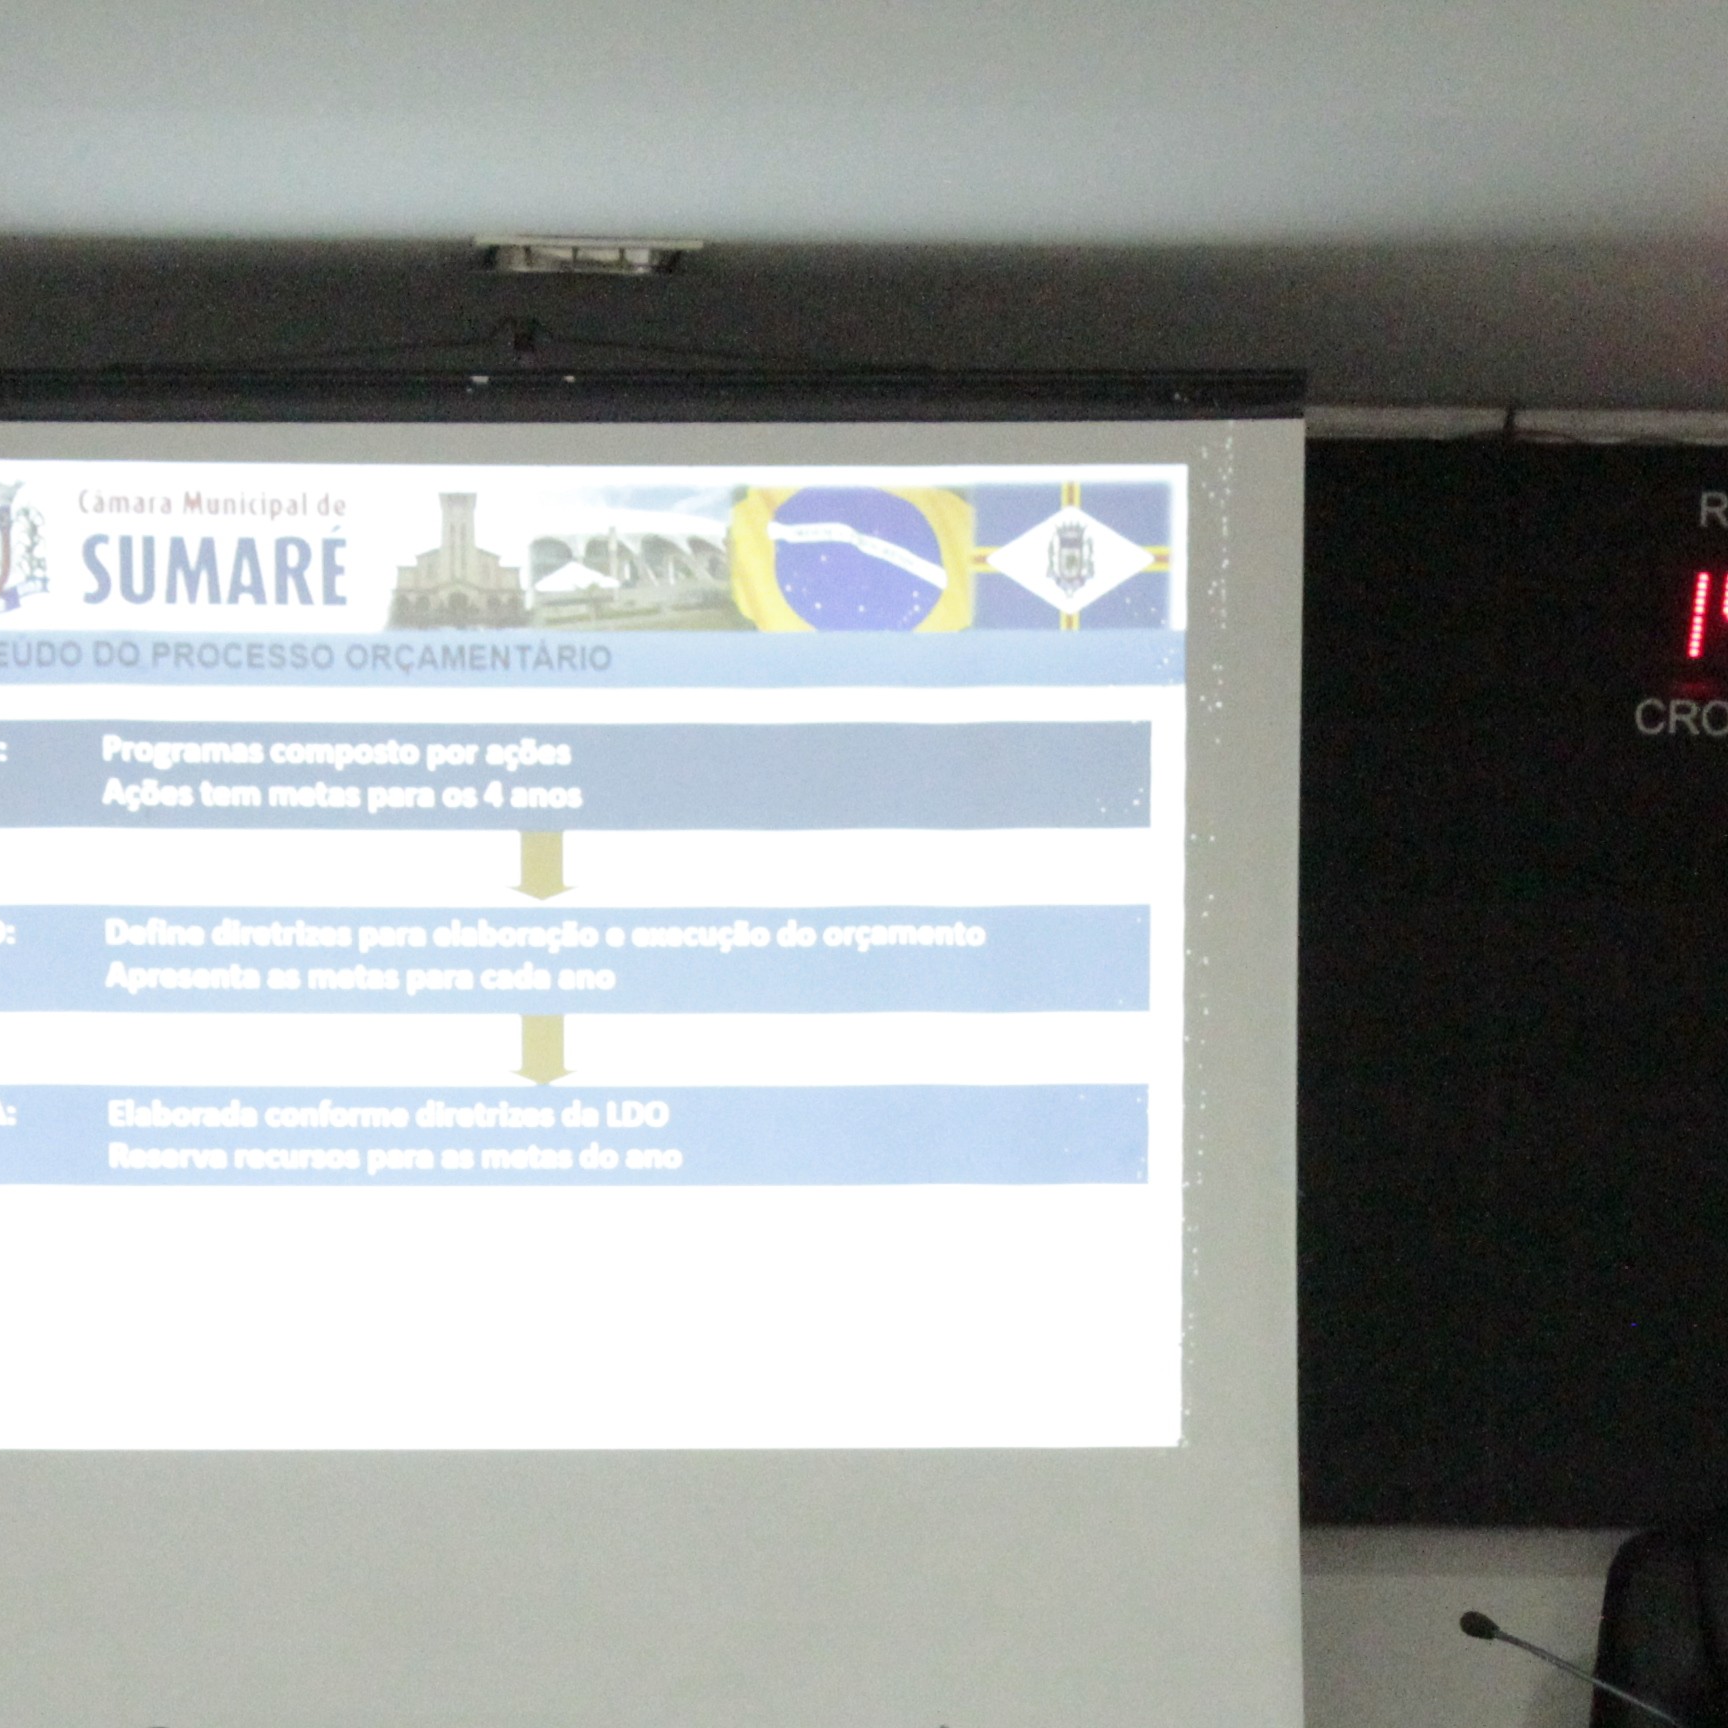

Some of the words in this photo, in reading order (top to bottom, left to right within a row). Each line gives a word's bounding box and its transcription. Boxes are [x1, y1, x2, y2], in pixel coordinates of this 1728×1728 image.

[77, 489, 174, 516] Câmara
[181, 491, 308, 521] Municipal
[317, 493, 348, 517] de
[81, 526, 349, 606] SUMARÉ
[92, 638, 142, 669] DO
[151, 641, 335, 672] PROCESSO
[344, 639, 613, 676] ORÇAMENTÁRIO
[103, 735, 264, 769] Programas
[270, 740, 420, 770] composto
[427, 744, 478, 771] por
[486, 738, 571, 771] ações
[103, 778, 194, 811] Ações
[200, 781, 261, 806] tem
[269, 782, 361, 807] metas
[368, 787, 435, 813] para
[511, 787, 582, 808] anos
[106, 918, 205, 946] Define
[211, 918, 352, 946] diretrizes
[359, 927, 426, 953] para
[632, 920, 770, 952] execução
[777, 919, 817, 947] do
[823, 922, 986, 952] orçamento
[106, 962, 260, 994] Apresenta
[308, 965, 399, 989] metas
[407, 969, 474, 995] para
[480, 962, 551, 989] cada
[558, 969, 616, 990] ano
[109, 1099, 258, 1127] Elaborada
[265, 1100, 409, 1127] conforme
[416, 1100, 555, 1128] diretrizes
[562, 1100, 599, 1127] da
[607, 1101, 669, 1127] LDO
[109, 1142, 227, 1169] Reserva
[234, 1149, 360, 1169] recursos
[368, 1149, 434, 1175] para
[482, 1145, 573, 1169] metas
[579, 1142, 619, 1169] do
[626, 1149, 683, 1168] ano
